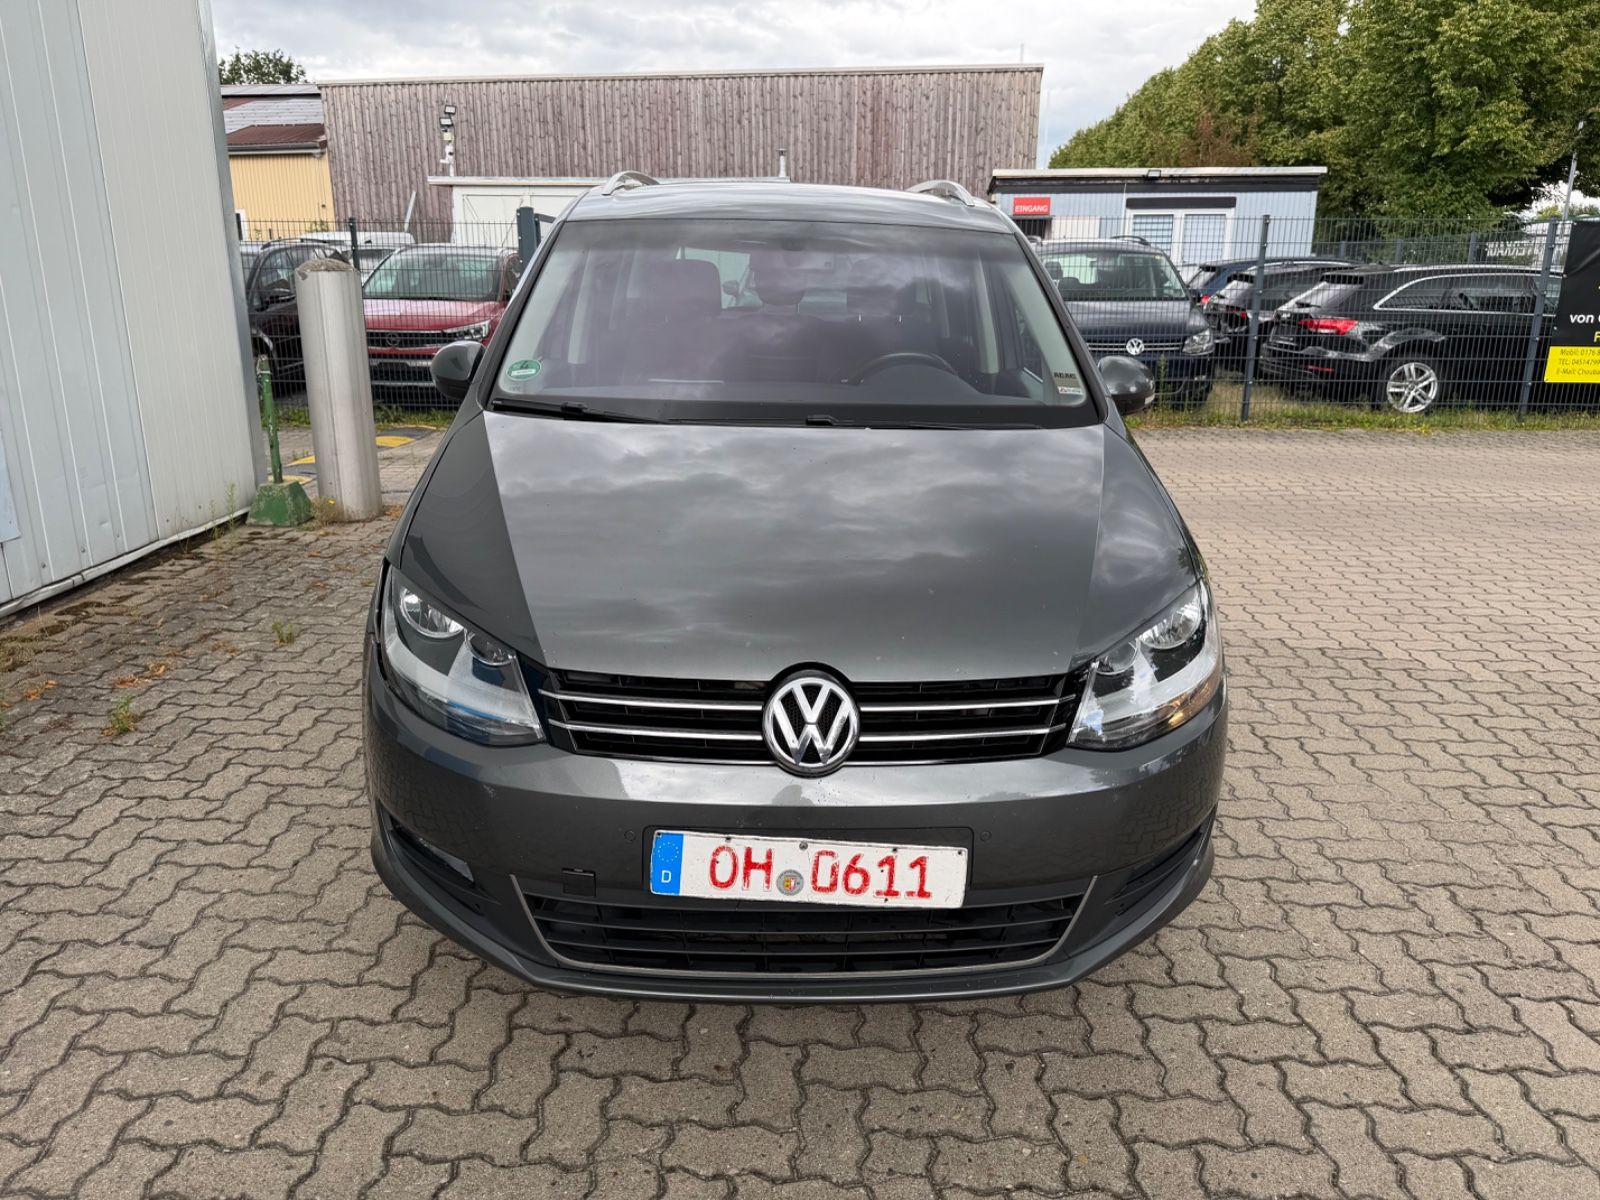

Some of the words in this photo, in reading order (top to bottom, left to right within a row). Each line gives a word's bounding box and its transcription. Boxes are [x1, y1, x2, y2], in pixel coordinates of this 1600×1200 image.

[1014, 204, 1049, 213] EINGANG
[1569, 314, 1594, 323] von
[763, 677, 859, 767] VW
[660, 869, 672, 883] D
[709, 845, 773, 891] OH
[810, 850, 932, 899] 0611
